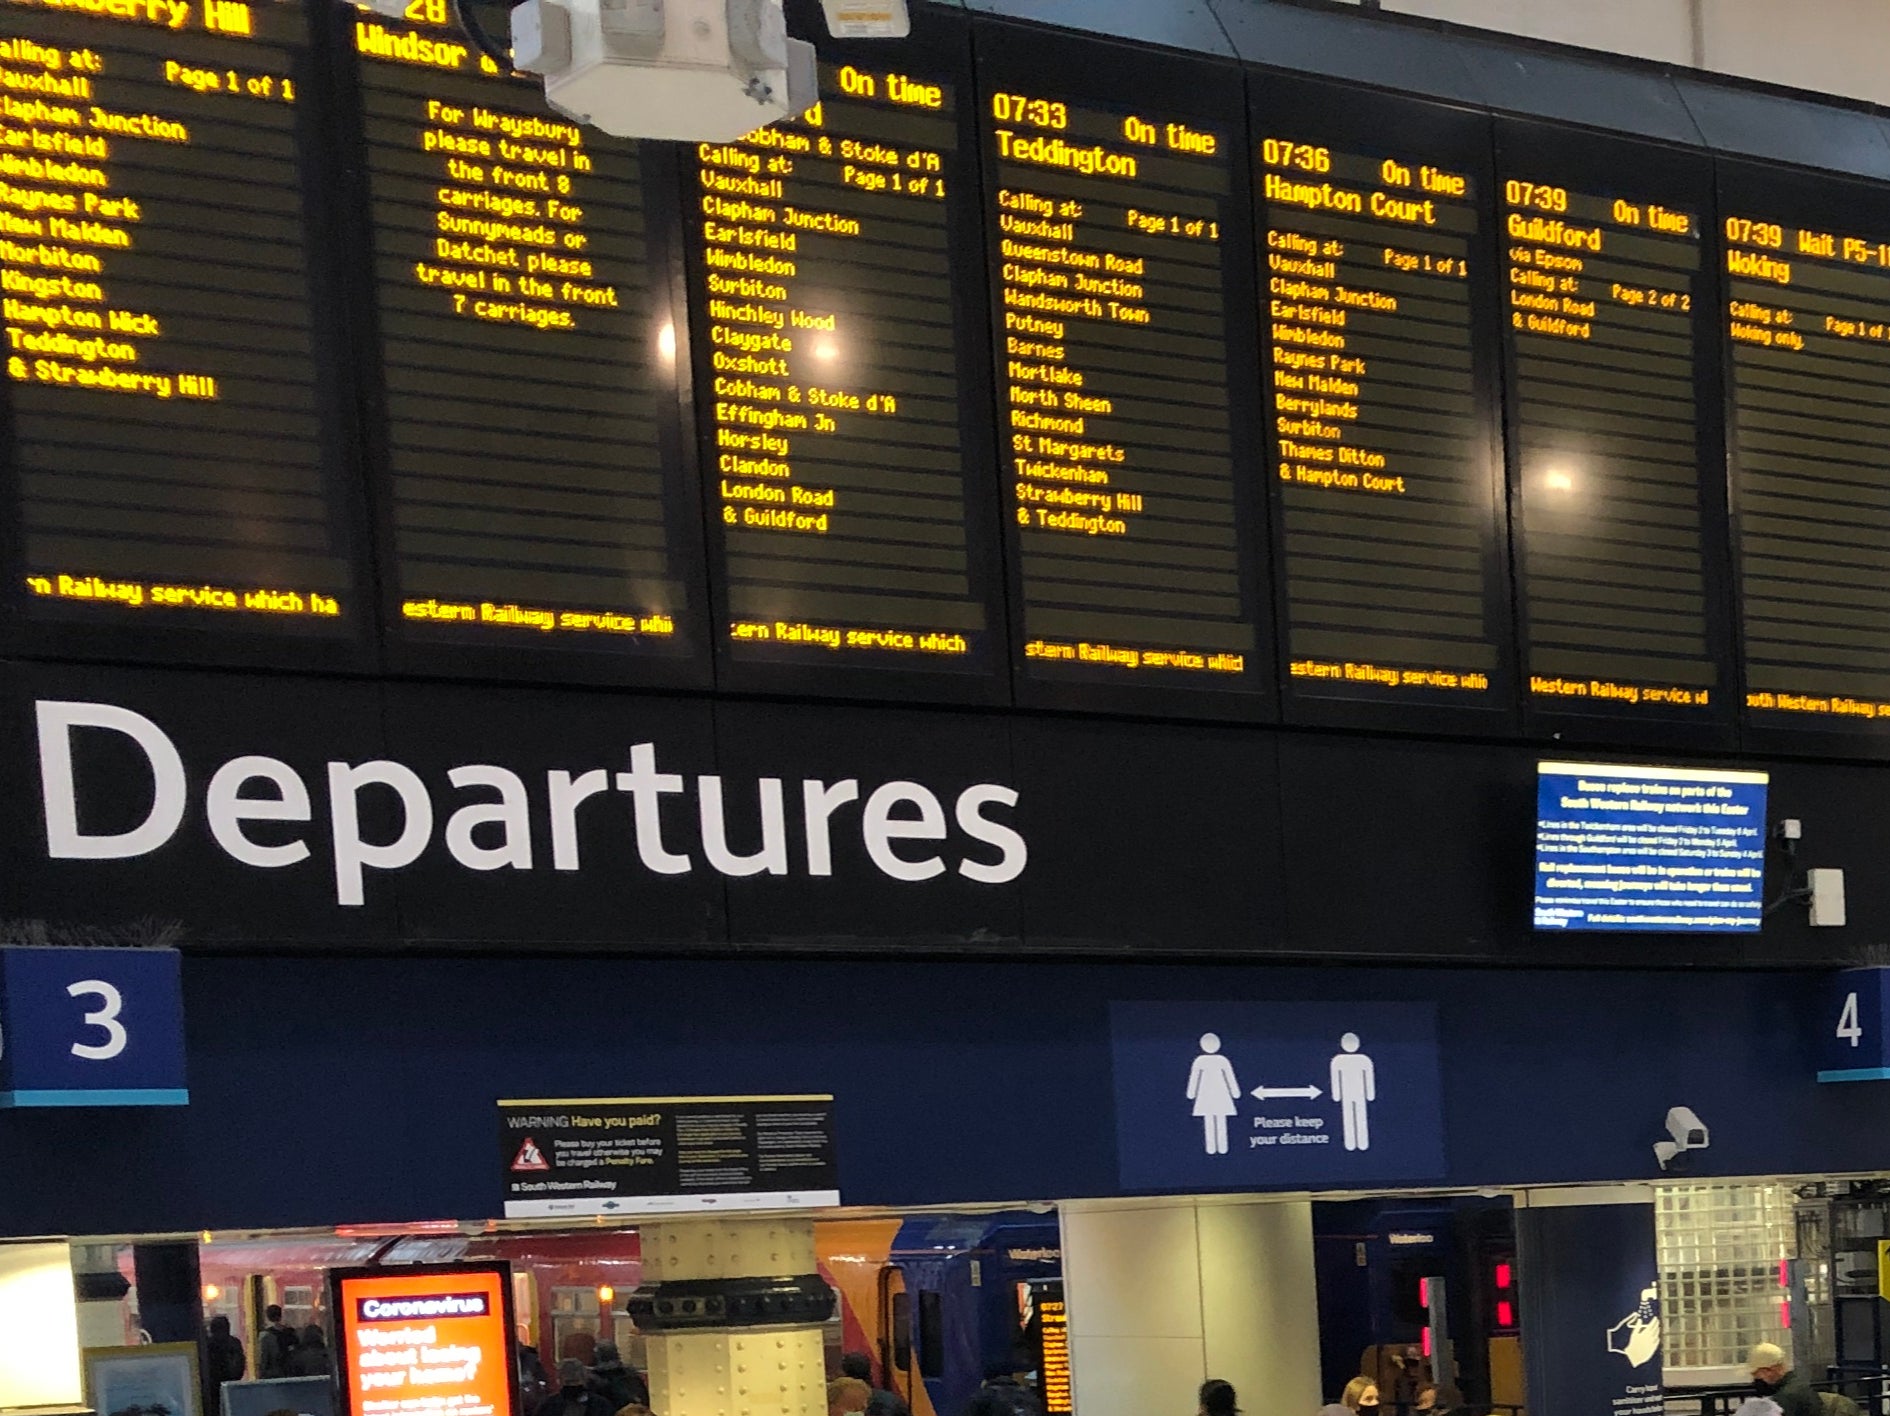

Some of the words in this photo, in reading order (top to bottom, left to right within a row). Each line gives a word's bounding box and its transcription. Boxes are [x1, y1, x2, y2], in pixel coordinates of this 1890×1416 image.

[355, 21, 468, 68] Windsor
[838, 64, 875, 97] On
[885, 72, 942, 108] time
[426, 99, 465, 124] For
[471, 107, 581, 147] Wraysbury
[992, 91, 1067, 129] 07:33
[1123, 114, 1156, 145] On
[1165, 122, 1216, 155] time
[422, 128, 491, 156] please
[497, 138, 566, 167] travel
[571, 149, 591, 171] in
[995, 128, 1136, 177] Teddington
[446, 157, 484, 182] the
[490, 164, 550, 192] front
[697, 141, 760, 175] Calling
[766, 154, 793, 174] at:
[842, 164, 886, 191] Page
[891, 172, 902, 191] 1
[906, 176, 929, 194] of
[934, 178, 945, 197] 1
[1262, 137, 1330, 173] 07:36
[1380, 158, 1411, 187] On
[1418, 164, 1465, 196] time
[699, 168, 783, 199] Vauxhall
[1263, 172, 1362, 213] Hampton
[1369, 190, 1436, 225] Court
[436, 187, 541, 218] carriages.
[546, 198, 583, 223] For
[701, 194, 776, 223] Clapham
[781, 206, 860, 235] Junction
[1505, 179, 1567, 213] 07:39
[1612, 198, 1640, 225] On
[1646, 204, 1689, 233] time
[703, 220, 796, 252] Earlsfield
[1506, 212, 1602, 252] Guildford
[1725, 216, 1783, 249] 07:39
[1797, 228, 1836, 257] Wait
[1000, 238, 1100, 269] Queenstown
[1103, 252, 1144, 275] Road
[1508, 246, 1532, 263] via
[1533, 248, 1583, 272] Epsom
[1726, 248, 1791, 284] Woking
[706, 272, 787, 301] Surbiton
[710, 324, 796, 354] Claygate
[1004, 310, 1064, 339] Putney
[1006, 335, 1065, 360] Barnes
[7, 355, 30, 379] &
[33, 358, 173, 398] Strawberry
[176, 373, 215, 398] Hill
[712, 350, 790, 377] Oxshott
[1007, 360, 1083, 387] Mortlake
[1274, 391, 1358, 419] Berrylands
[1009, 408, 1084, 434] Richmond
[716, 427, 789, 457] Horsley
[718, 453, 790, 478] Clandon
[34, 699, 1028, 906] Departures
[66, 979, 127, 1060] 3
[1836, 992, 1862, 1047] 4
[507, 1116, 569, 1128] WARNING
[571, 1115, 602, 1128] Have
[605, 1117, 626, 1129] you
[629, 1114, 661, 1128] paid?
[1253, 1117, 1293, 1128] Please
[1294, 1116, 1324, 1129] keep
[554, 1140, 580, 1148] Please
[581, 1140, 595, 1149] buy
[596, 1140, 613, 1149] your
[636, 1138, 661, 1146] before
[555, 1150, 569, 1158] you
[631, 1149, 645, 1158] you
[1249, 1136, 1278, 1148] your
[1279, 1133, 1329, 1144] distance
[605, 1157, 634, 1167] Penalty
[521, 1182, 547, 1191] South
[547, 1181, 583, 1190] Western
[582, 1180, 617, 1190] Railway
[1388, 1233, 1434, 1245] Waterloo
[364, 1297, 483, 1318] Coronavirus
[357, 1325, 436, 1347] Worried
[359, 1348, 417, 1368] about
[421, 1344, 482, 1366] losing
[360, 1371, 406, 1391] your
